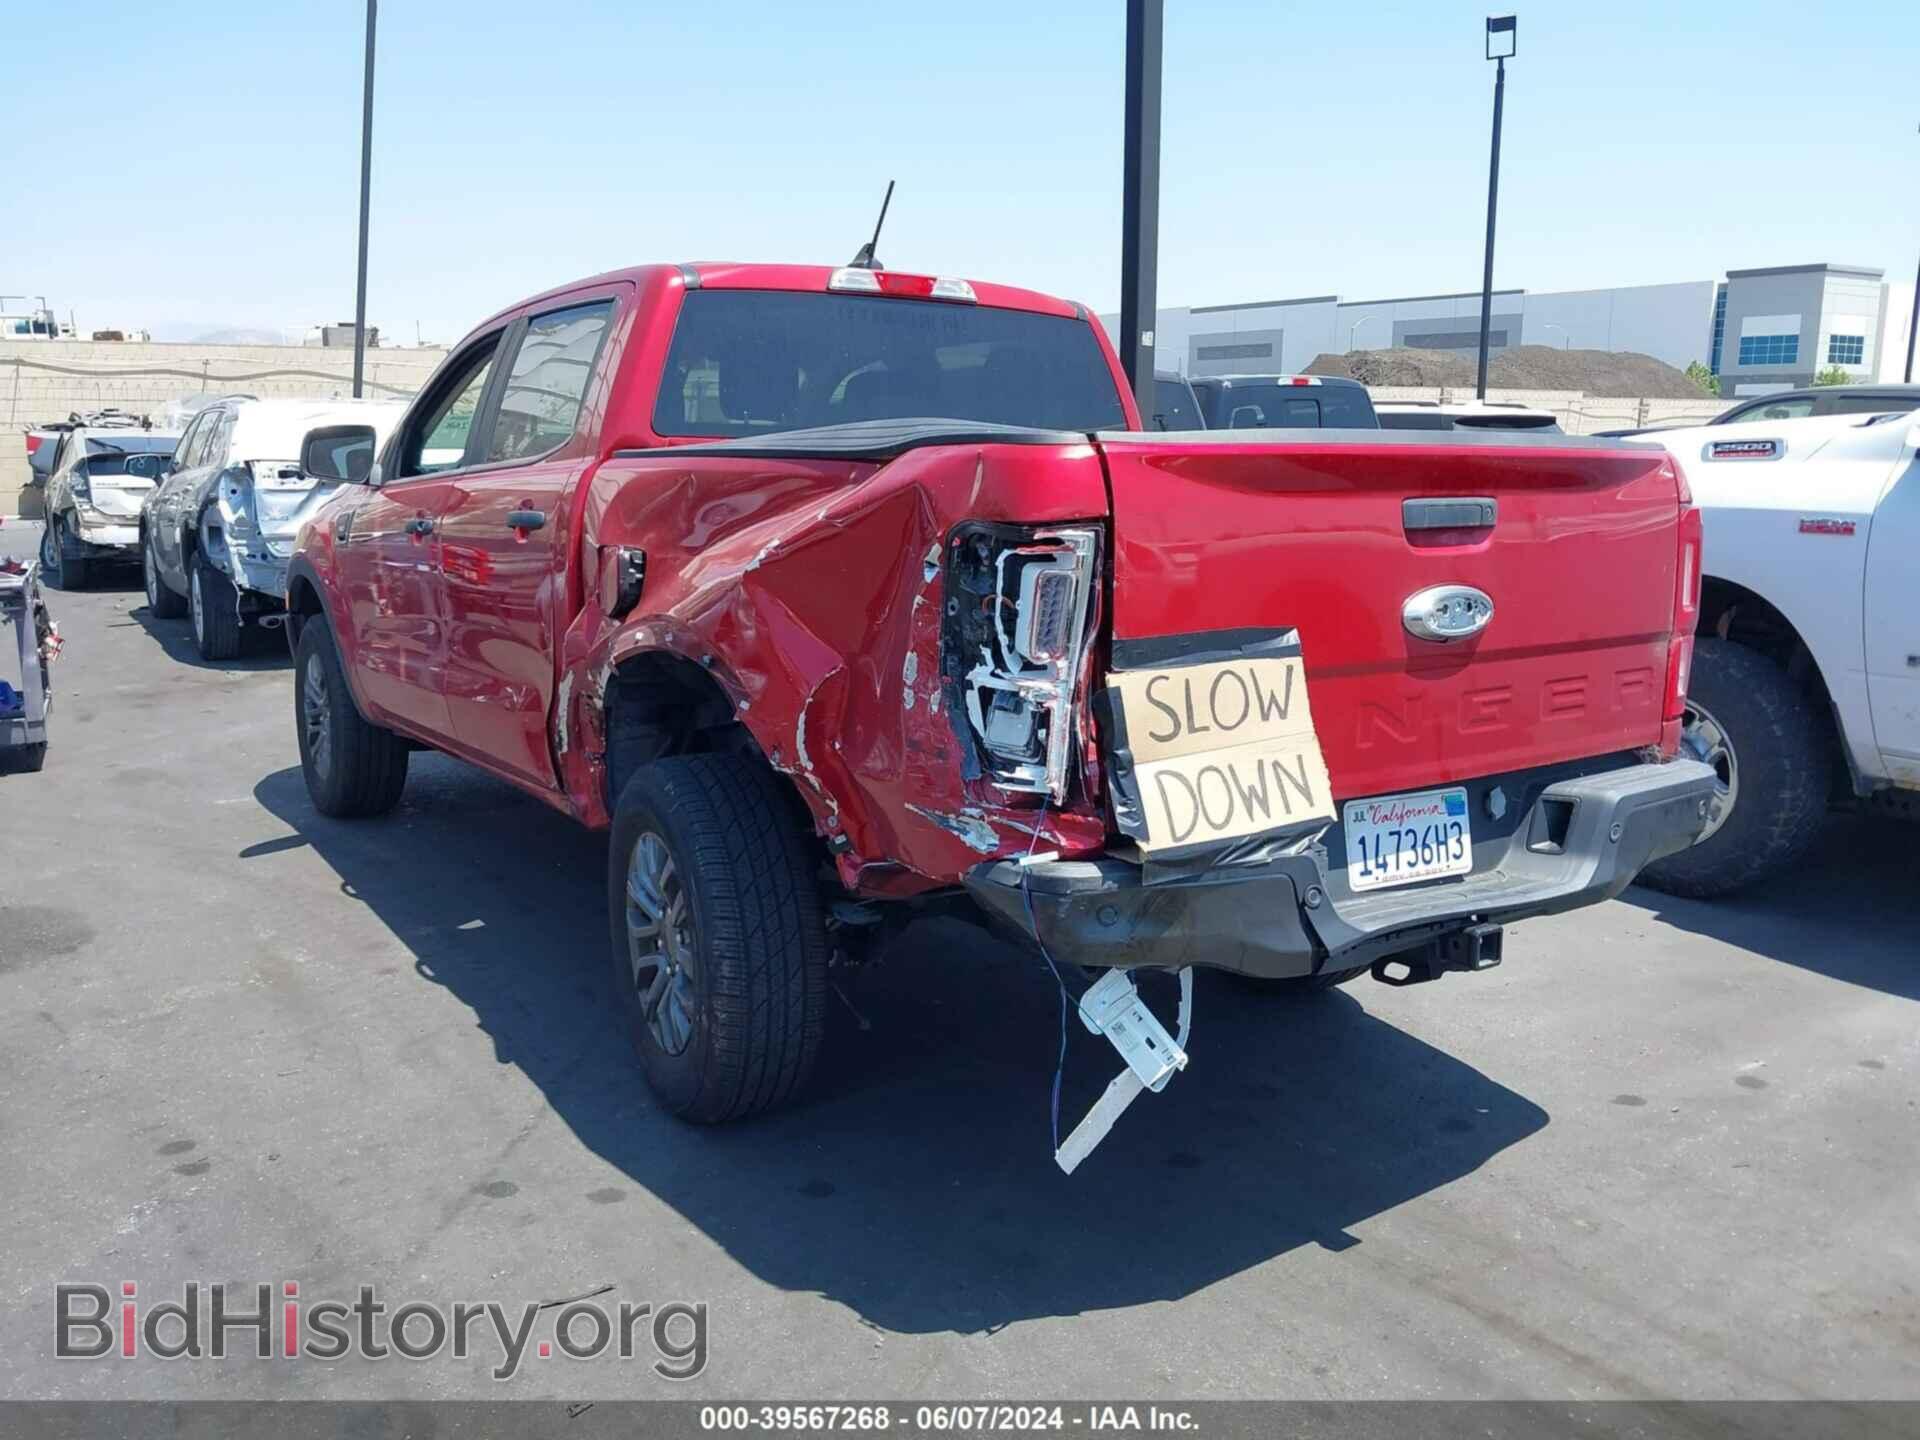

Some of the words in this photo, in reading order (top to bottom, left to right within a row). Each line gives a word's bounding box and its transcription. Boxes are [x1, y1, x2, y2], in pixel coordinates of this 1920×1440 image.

[1145, 664, 1294, 743] SLOW
[1354, 667, 1656, 749] NGER
[1153, 753, 1315, 843] DOWN
[1371, 802, 1442, 827] California
[1357, 820, 1465, 877] 14736H3
